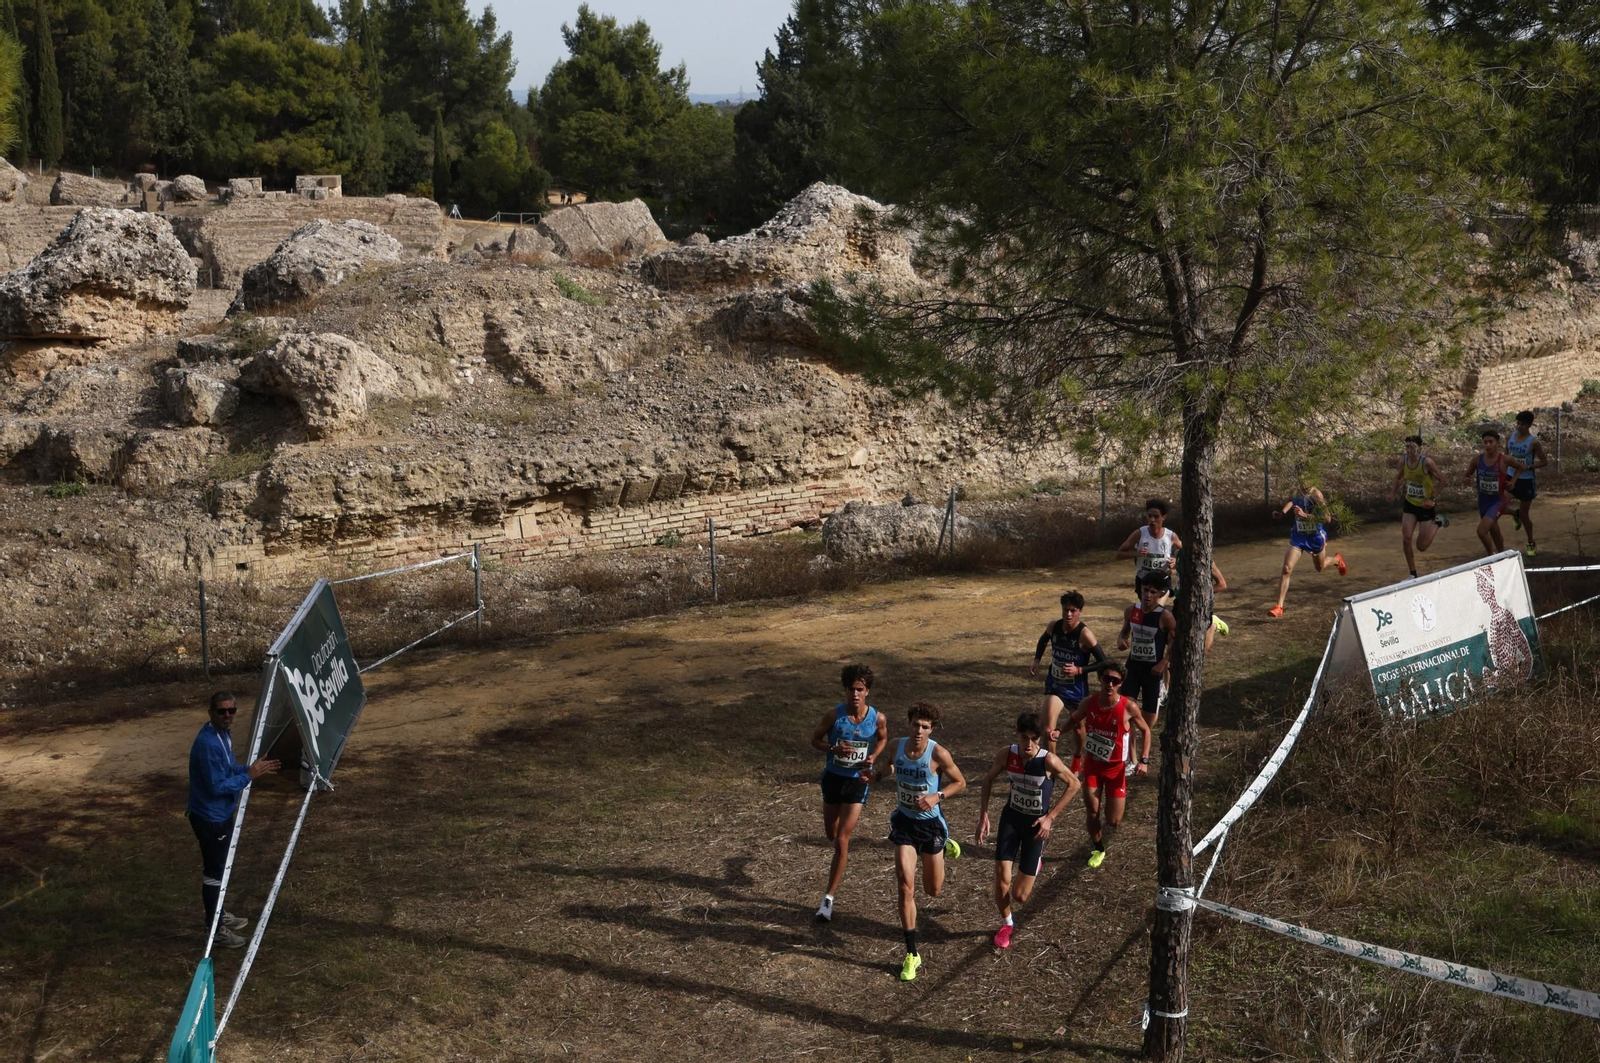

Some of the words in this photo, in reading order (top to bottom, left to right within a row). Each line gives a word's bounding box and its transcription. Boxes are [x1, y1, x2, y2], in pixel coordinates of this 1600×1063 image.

[1132, 645, 1154, 655] 6402
[1380, 636, 1400, 649] Sevilla
[1413, 641, 1430, 654] CROSS
[1430, 636, 1453, 648] COUNTRY
[310, 630, 338, 675] Diputación
[1399, 650, 1462, 677] INTERNACIONAL
[1461, 646, 1471, 657] DE
[319, 657, 350, 711] Sevilla
[1085, 740, 1110, 759] 6162
[896, 766, 927, 779] nerja
[1013, 793, 1040, 809] 6400
